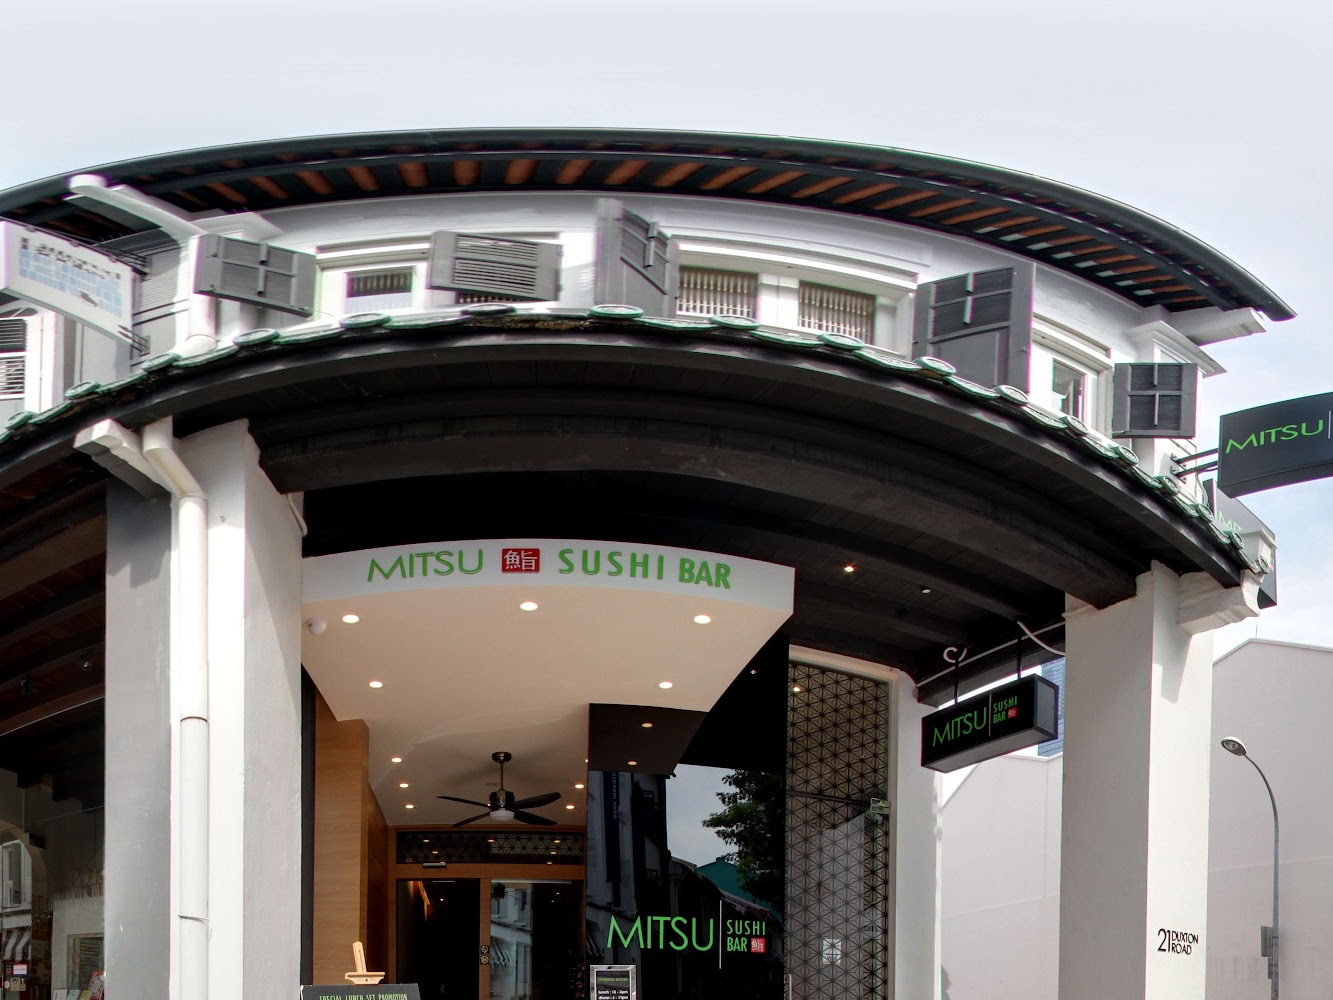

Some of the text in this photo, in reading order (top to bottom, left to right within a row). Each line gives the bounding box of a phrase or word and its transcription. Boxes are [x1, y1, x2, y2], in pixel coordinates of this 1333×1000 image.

[1225, 419, 1324, 454] MITSU
[367, 549, 483, 582] MITSU
[558, 549, 731, 589] SUSHI BAR
[993, 696, 1018, 713] SUSHI
[933, 706, 987, 747] MITSU
[993, 711, 1007, 724] BAR
[606, 914, 714, 951] MITSU
[726, 919, 766, 936] SUSHI
[726, 937, 748, 952] BAR
[1157, 928, 1199, 953] 21 DUXTON
[1171, 942, 1193, 956] ROAD
